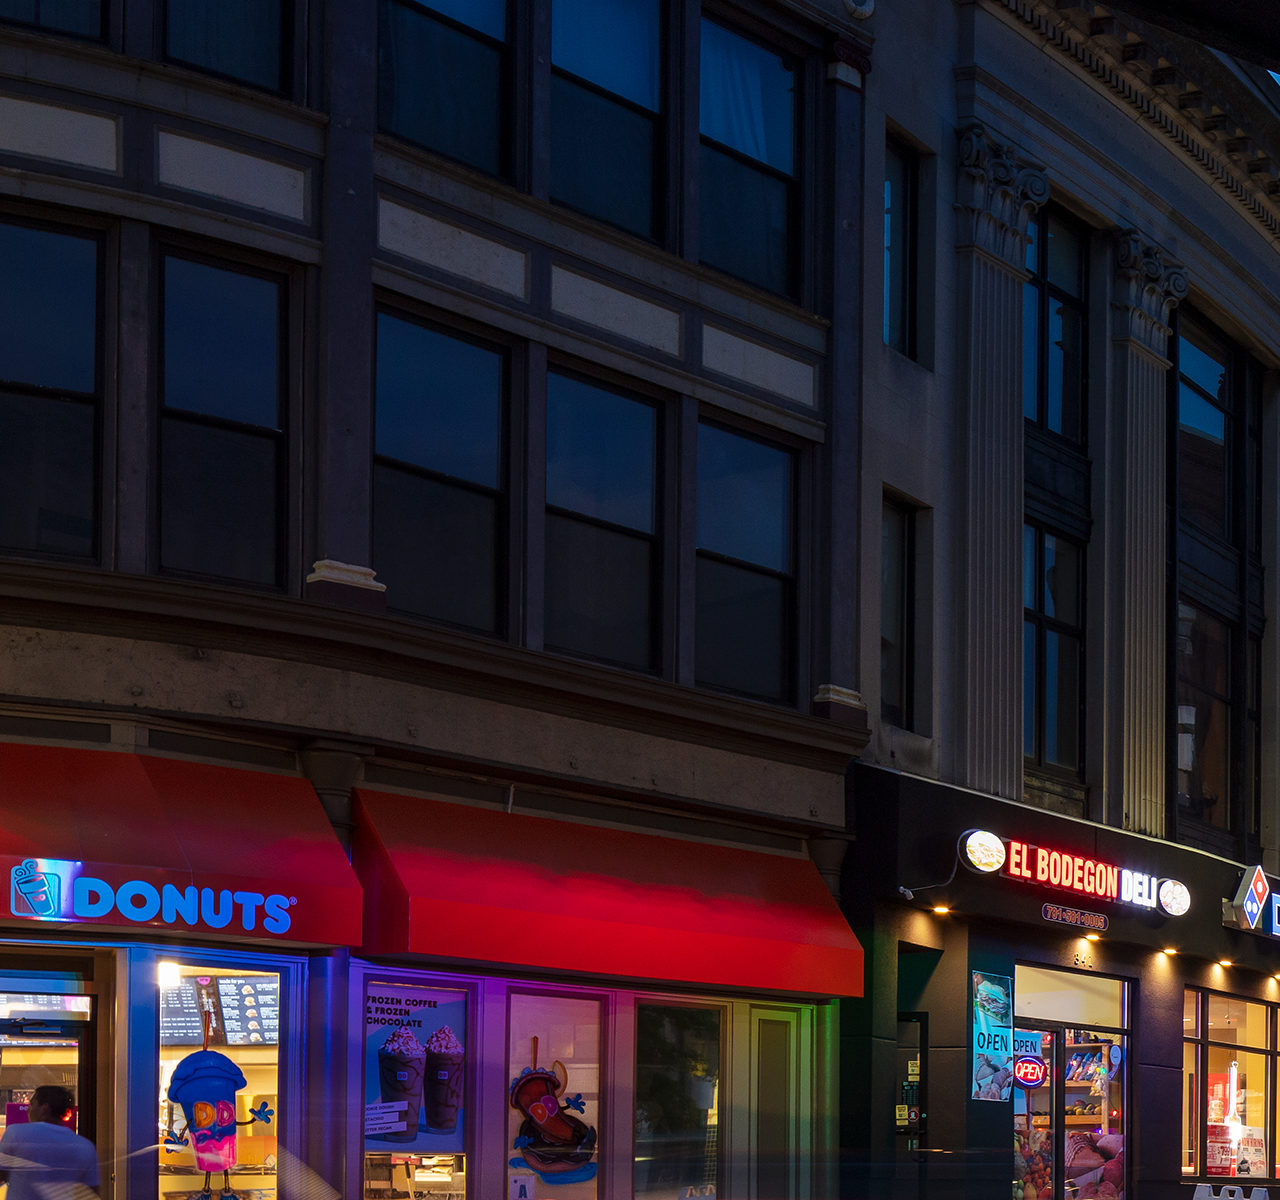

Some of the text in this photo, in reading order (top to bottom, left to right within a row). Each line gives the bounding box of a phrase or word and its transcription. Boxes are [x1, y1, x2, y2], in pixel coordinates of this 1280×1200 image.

[1009, 841, 1158, 909] EL BODEGON DELI
[73, 876, 292, 934] DONUTS
[366, 995, 438, 1009] FROZEN COFFEE
[375, 1006, 410, 1017] FROZEN
[366, 1016, 423, 1028] CHOCOLATE
[977, 1032, 1008, 1052] OPEN
[1014, 1039, 1037, 1053] OPEN
[1015, 1062, 1045, 1080] OPEN
